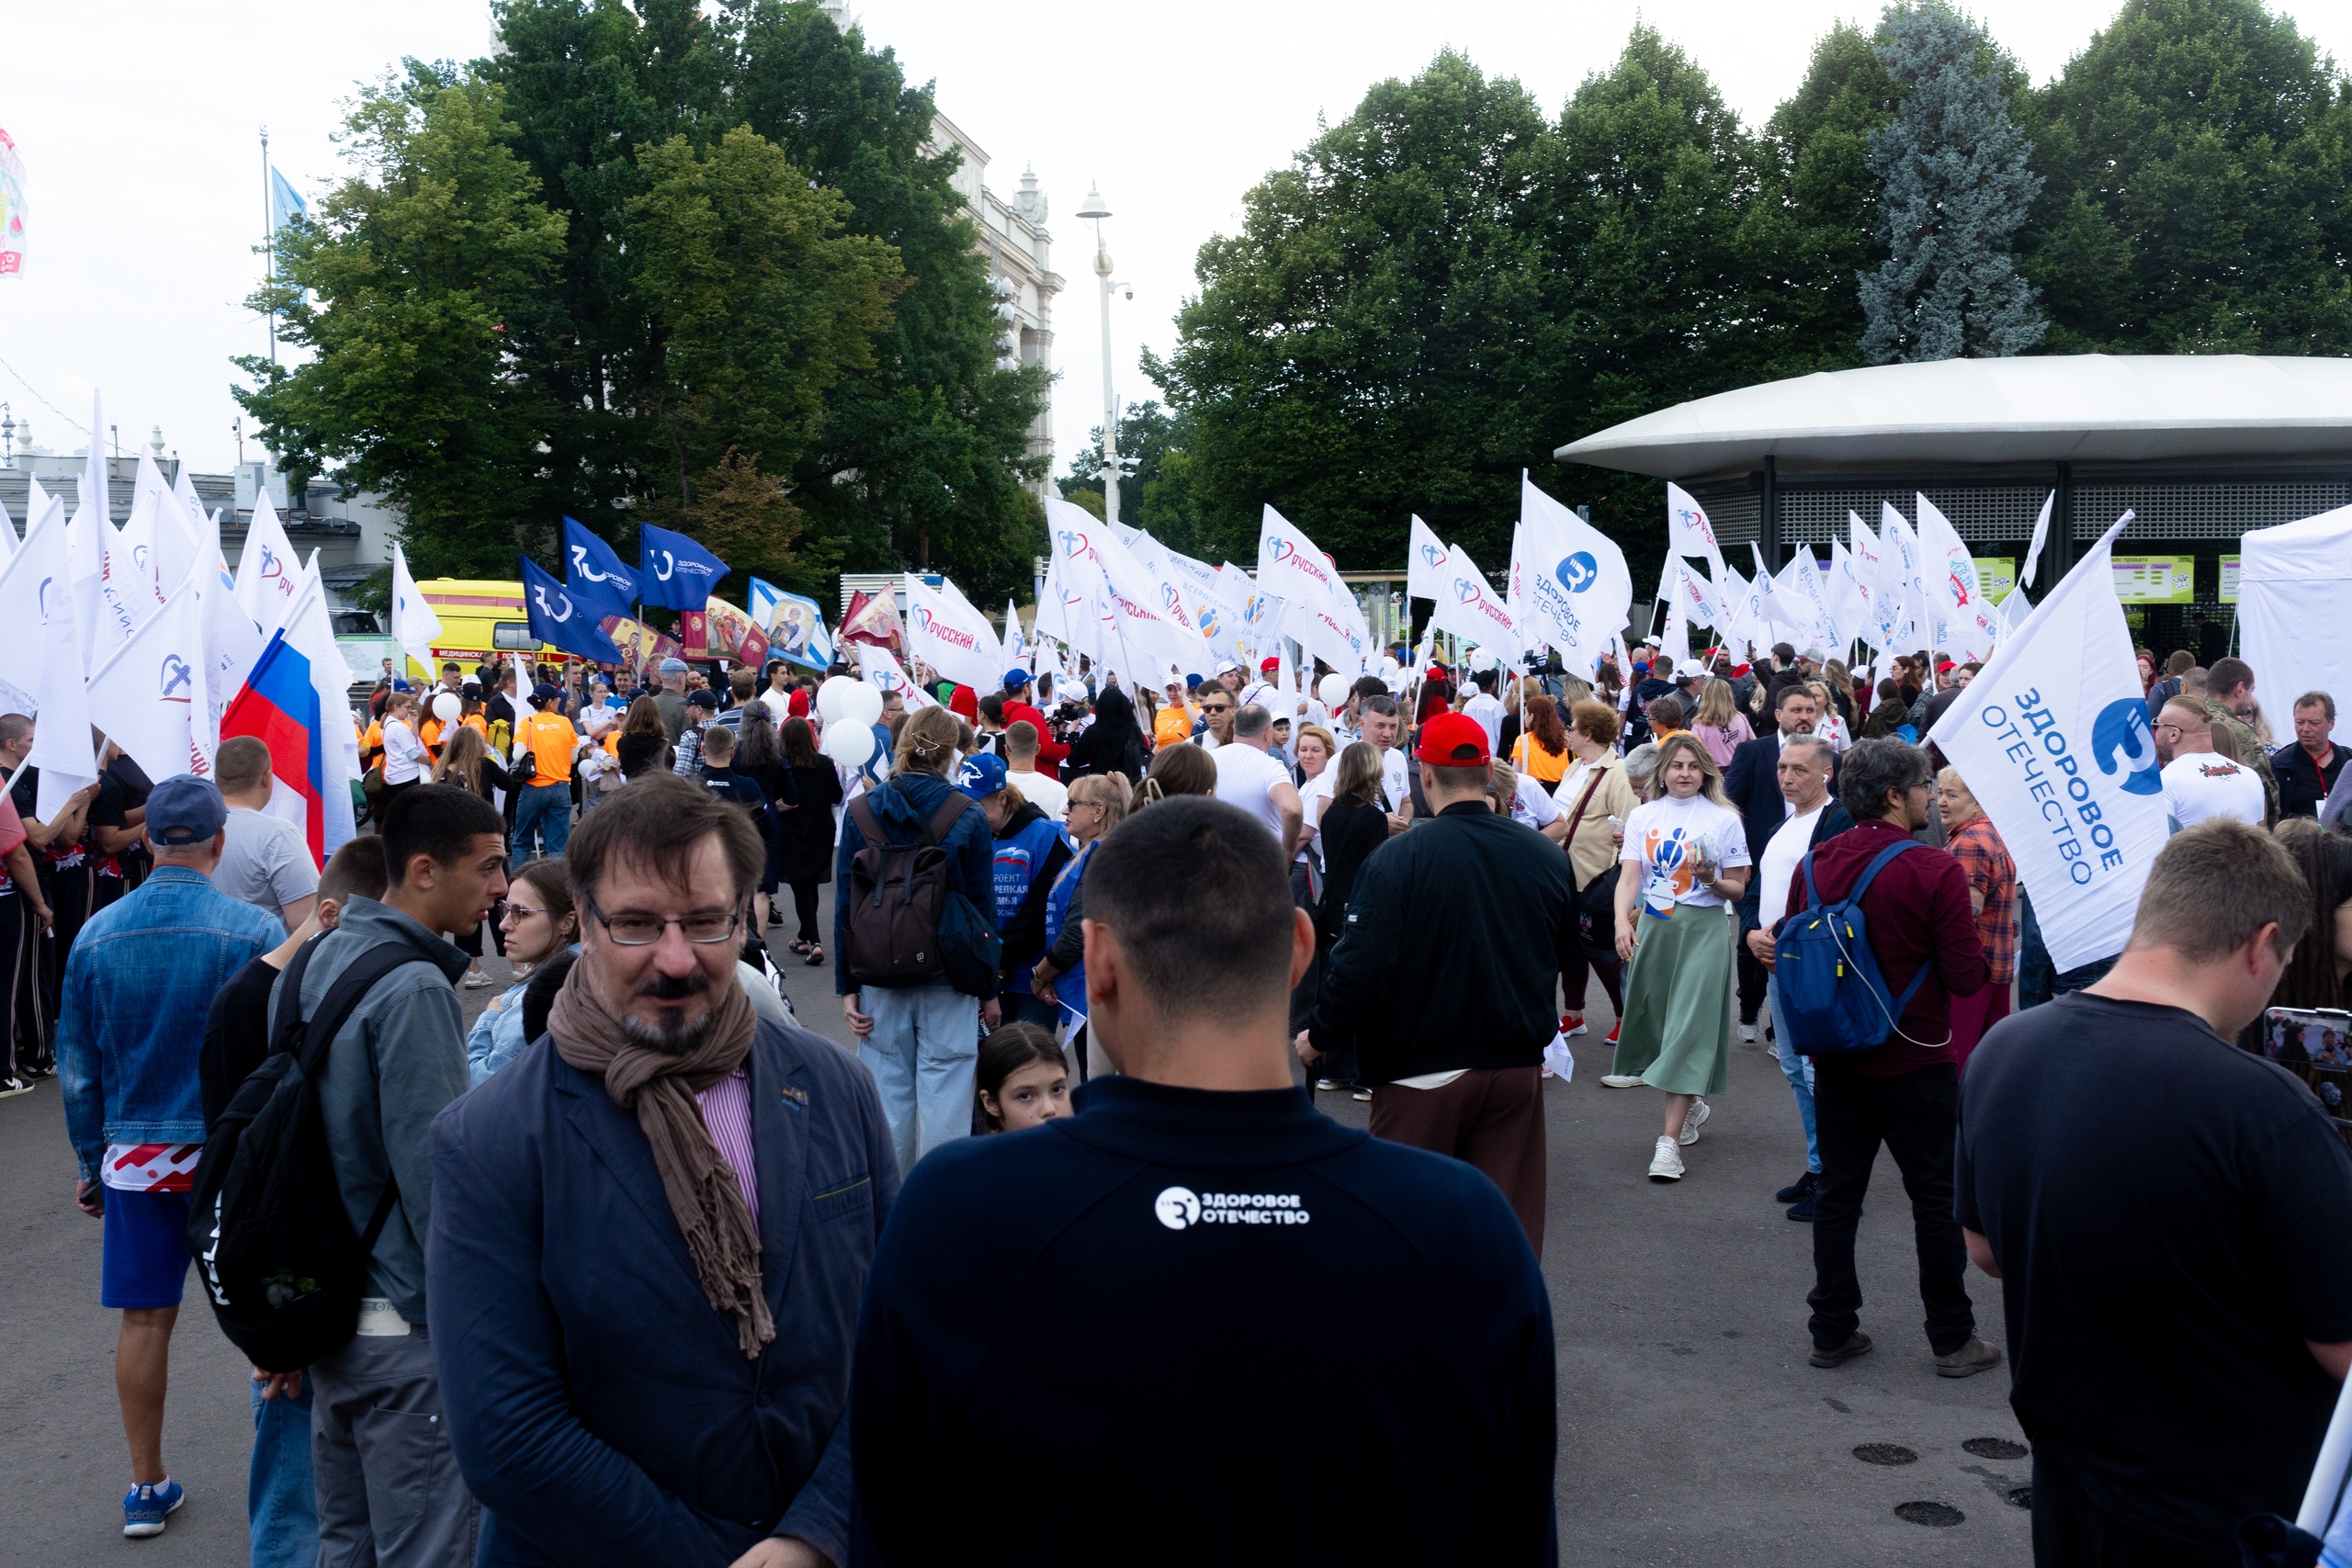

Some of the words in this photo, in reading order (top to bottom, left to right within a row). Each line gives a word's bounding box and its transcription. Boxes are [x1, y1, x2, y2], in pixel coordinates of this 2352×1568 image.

[675, 567, 710, 577] ОТЕЧЕСТВО
[677, 560, 714, 572] ЗДОРОВОЕ
[603, 570, 632, 587] ОРОВОЕ
[930, 622, 974, 650] РУССКИЙ
[2015, 687, 2123, 873] ЗДОРОВОЕ
[1982, 705, 2093, 886] ОТЕЧЕСТВО
[994, 874, 1021, 882] РОЕКТ
[994, 886, 1028, 894] РЕПКАЯ
[996, 897, 1018, 905] ЕМЬЯ
[1202, 1192, 1301, 1209] ЗДОРОВОЕ
[1202, 1209, 1310, 1224] ОТЕЧЕСТВО
